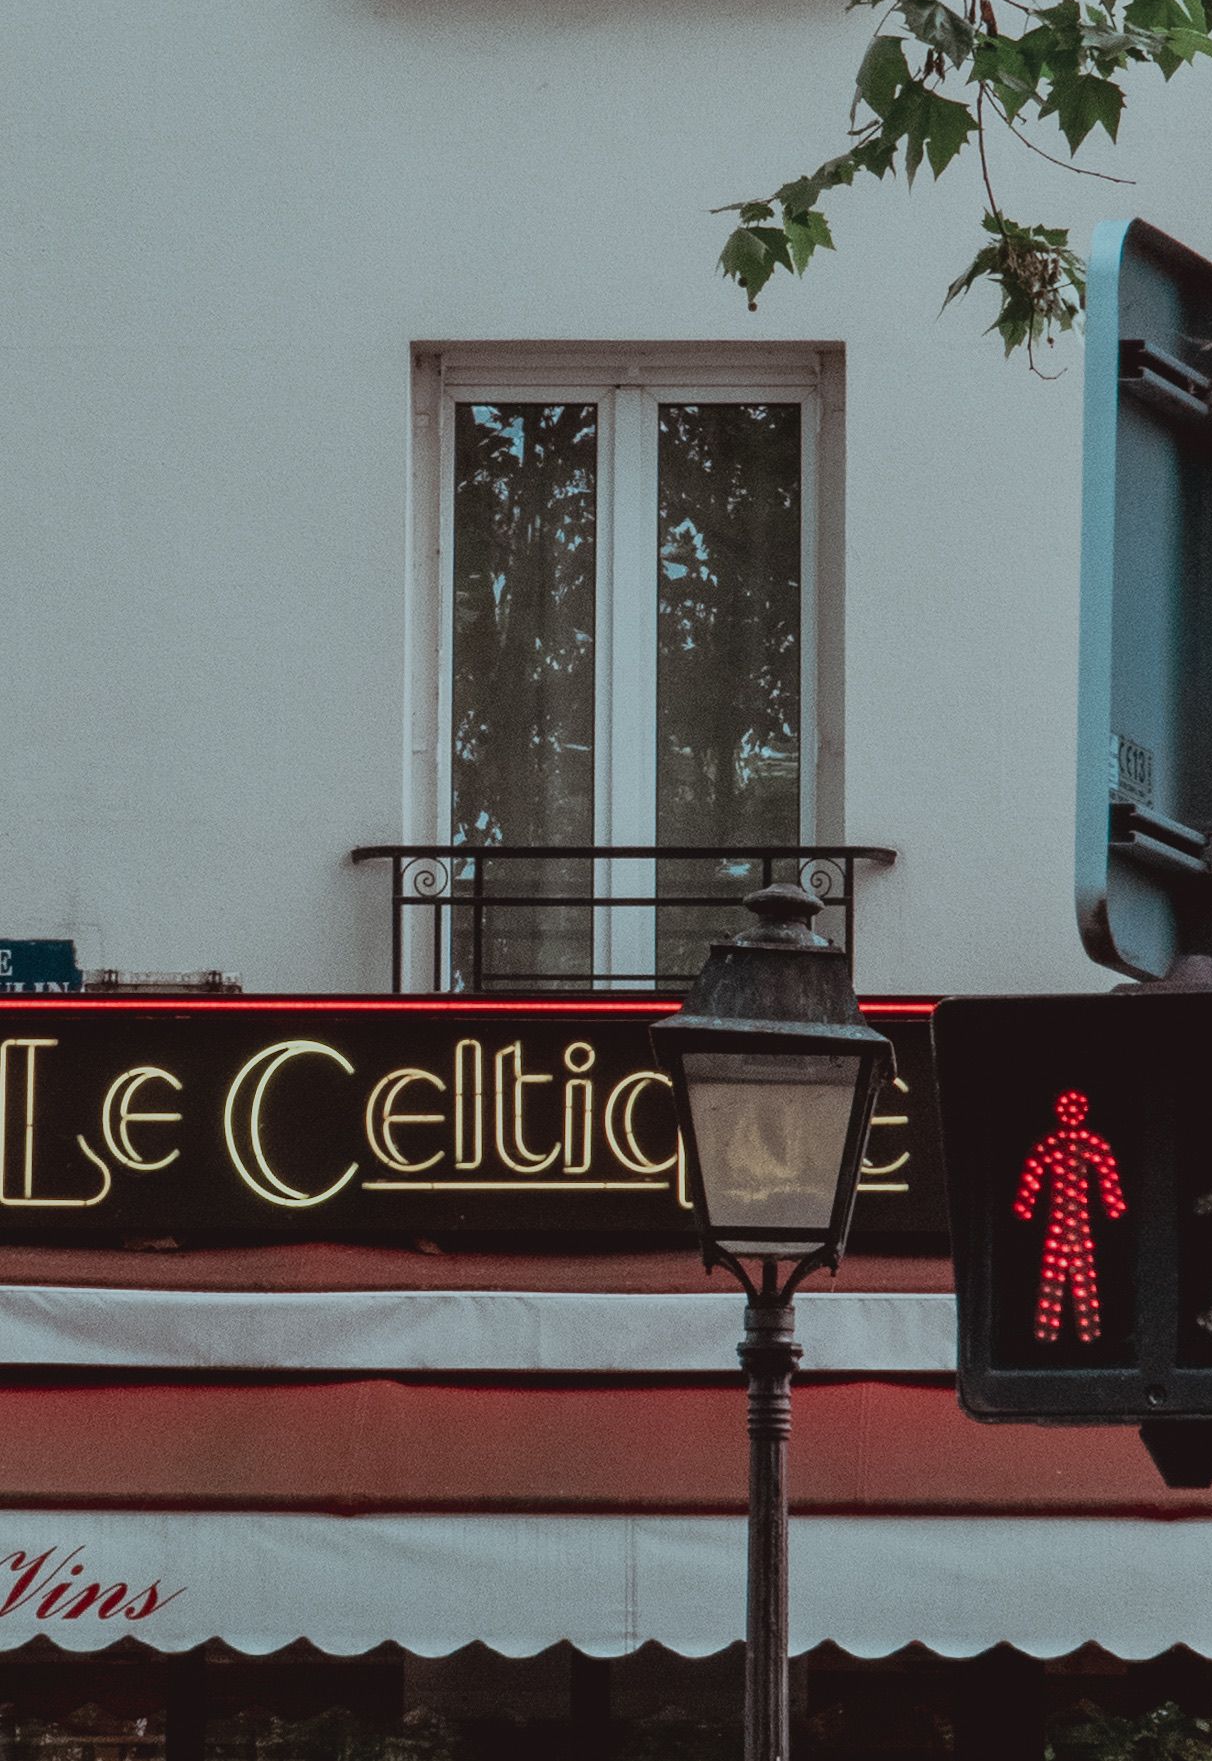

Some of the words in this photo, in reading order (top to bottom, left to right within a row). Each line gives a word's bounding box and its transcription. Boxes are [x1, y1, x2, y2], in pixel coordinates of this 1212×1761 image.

[0, 1039, 183, 1207] Le
[224, 1039, 910, 1209] Celtiqe
[0, 1545, 188, 1621] Vins
